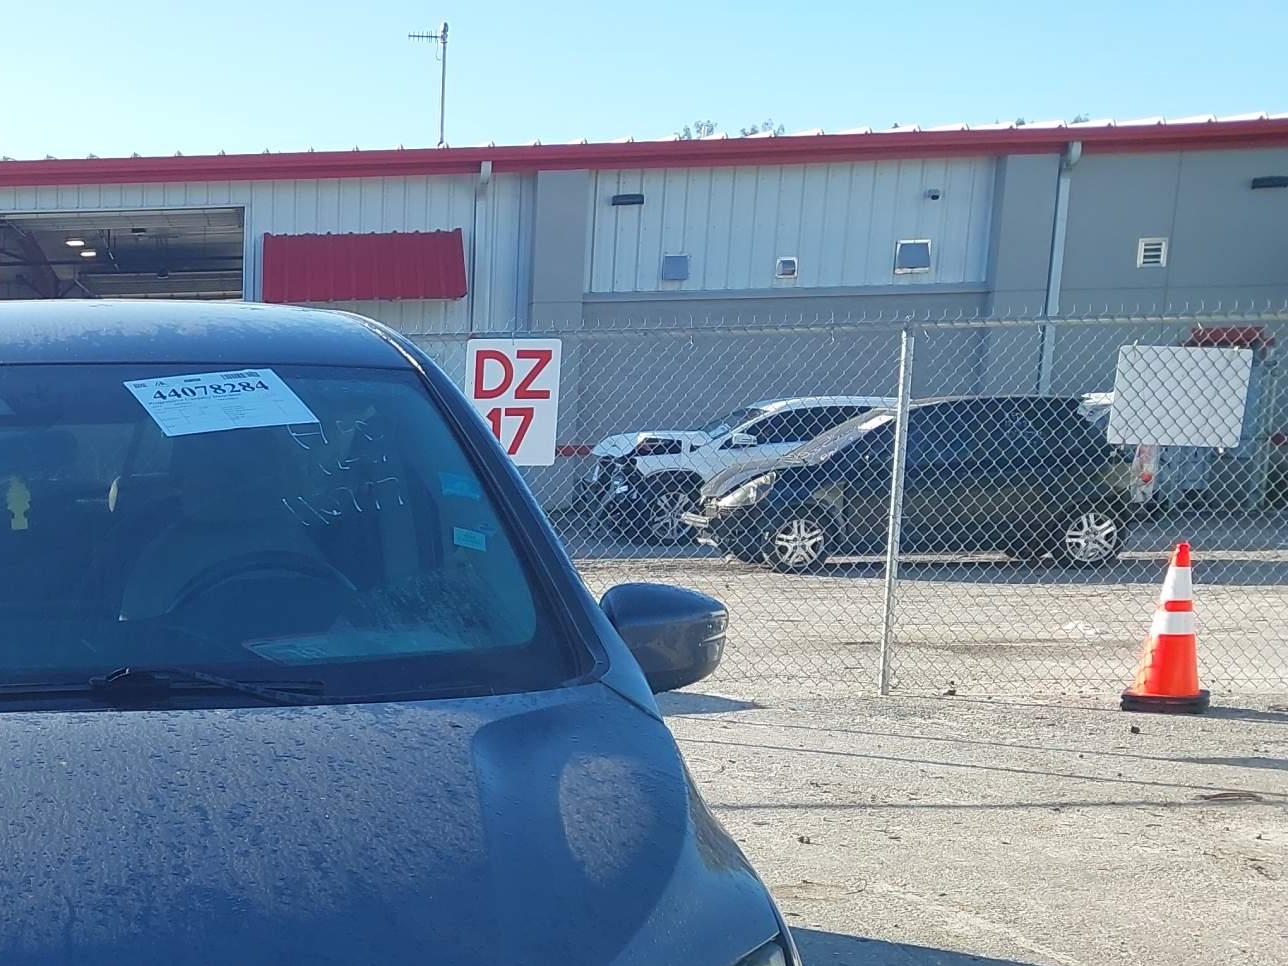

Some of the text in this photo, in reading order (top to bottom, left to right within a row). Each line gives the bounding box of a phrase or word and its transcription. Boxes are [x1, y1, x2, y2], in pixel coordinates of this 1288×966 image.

[151, 379, 270, 401] 44078284
[473, 349, 553, 400] DZ
[485, 407, 535, 456] 17
